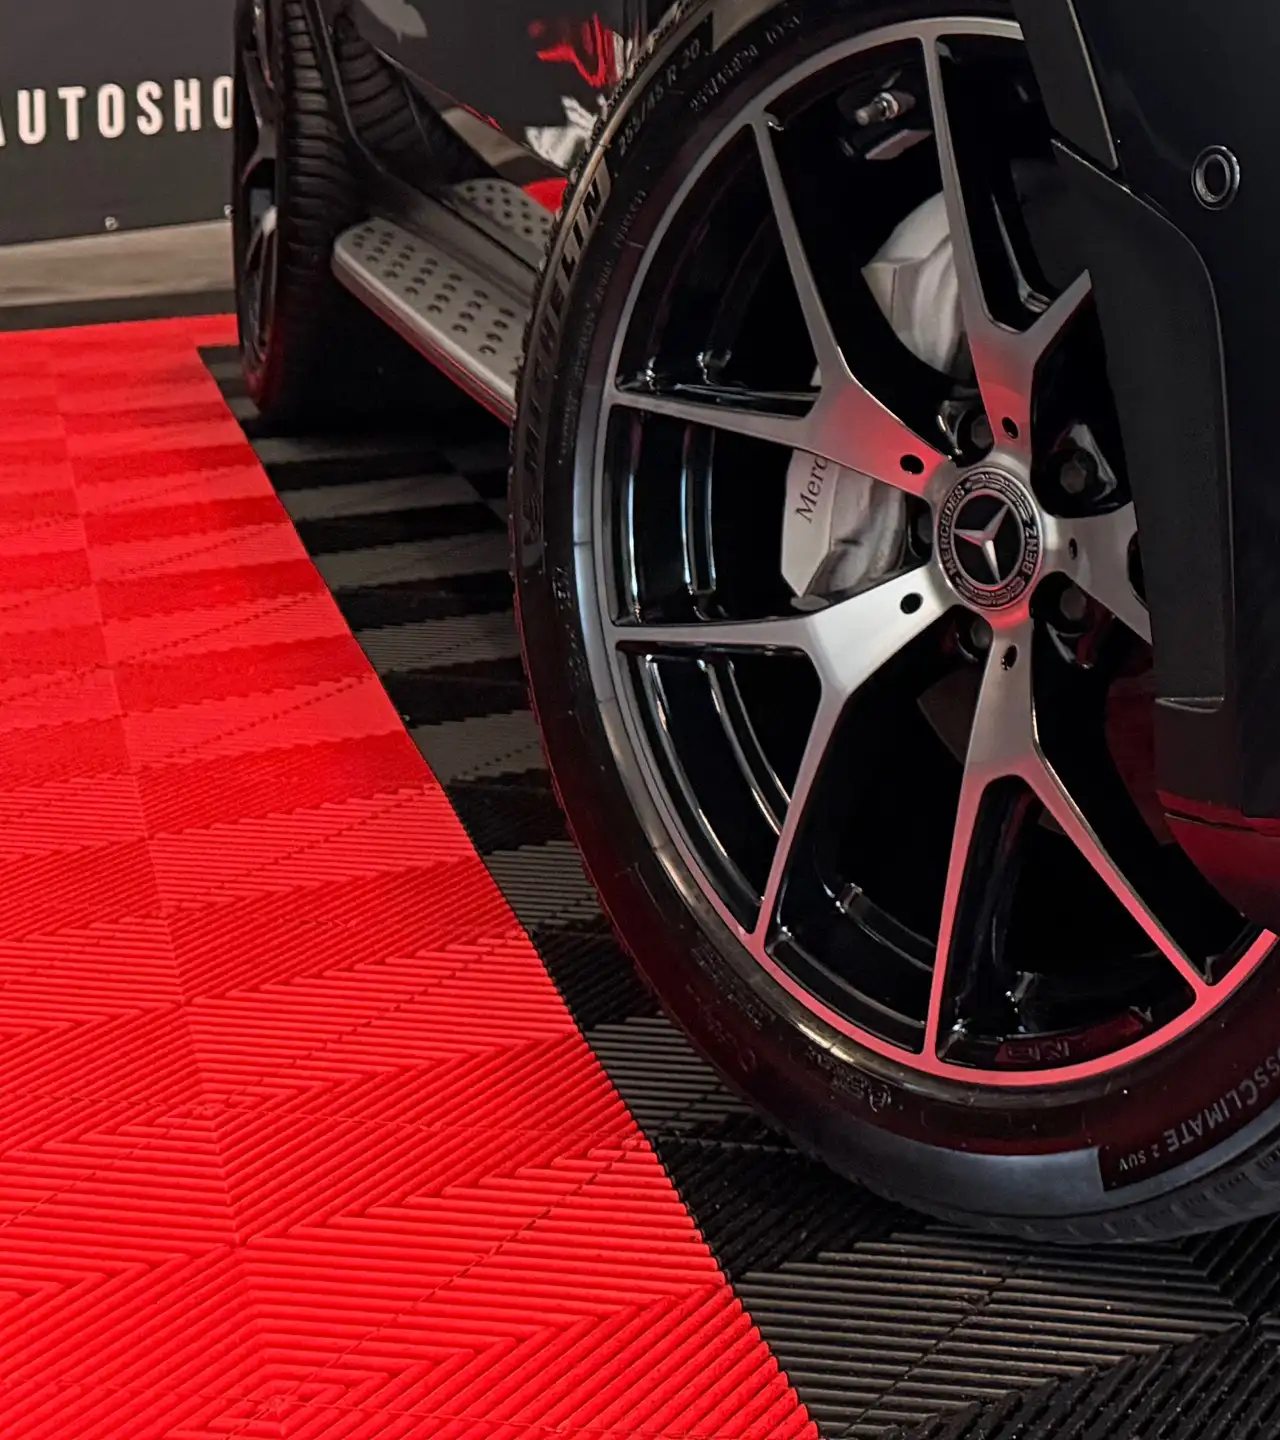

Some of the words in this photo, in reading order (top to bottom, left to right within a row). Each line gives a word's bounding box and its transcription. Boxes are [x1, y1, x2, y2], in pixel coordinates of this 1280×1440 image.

[0, 75, 234, 147] UTOSHO
[939, 485, 966, 578] MERCEDES
[1021, 523, 1041, 576] BENZ
[1117, 1149, 1148, 1172] SUV
[1150, 1143, 1160, 1160] 2
